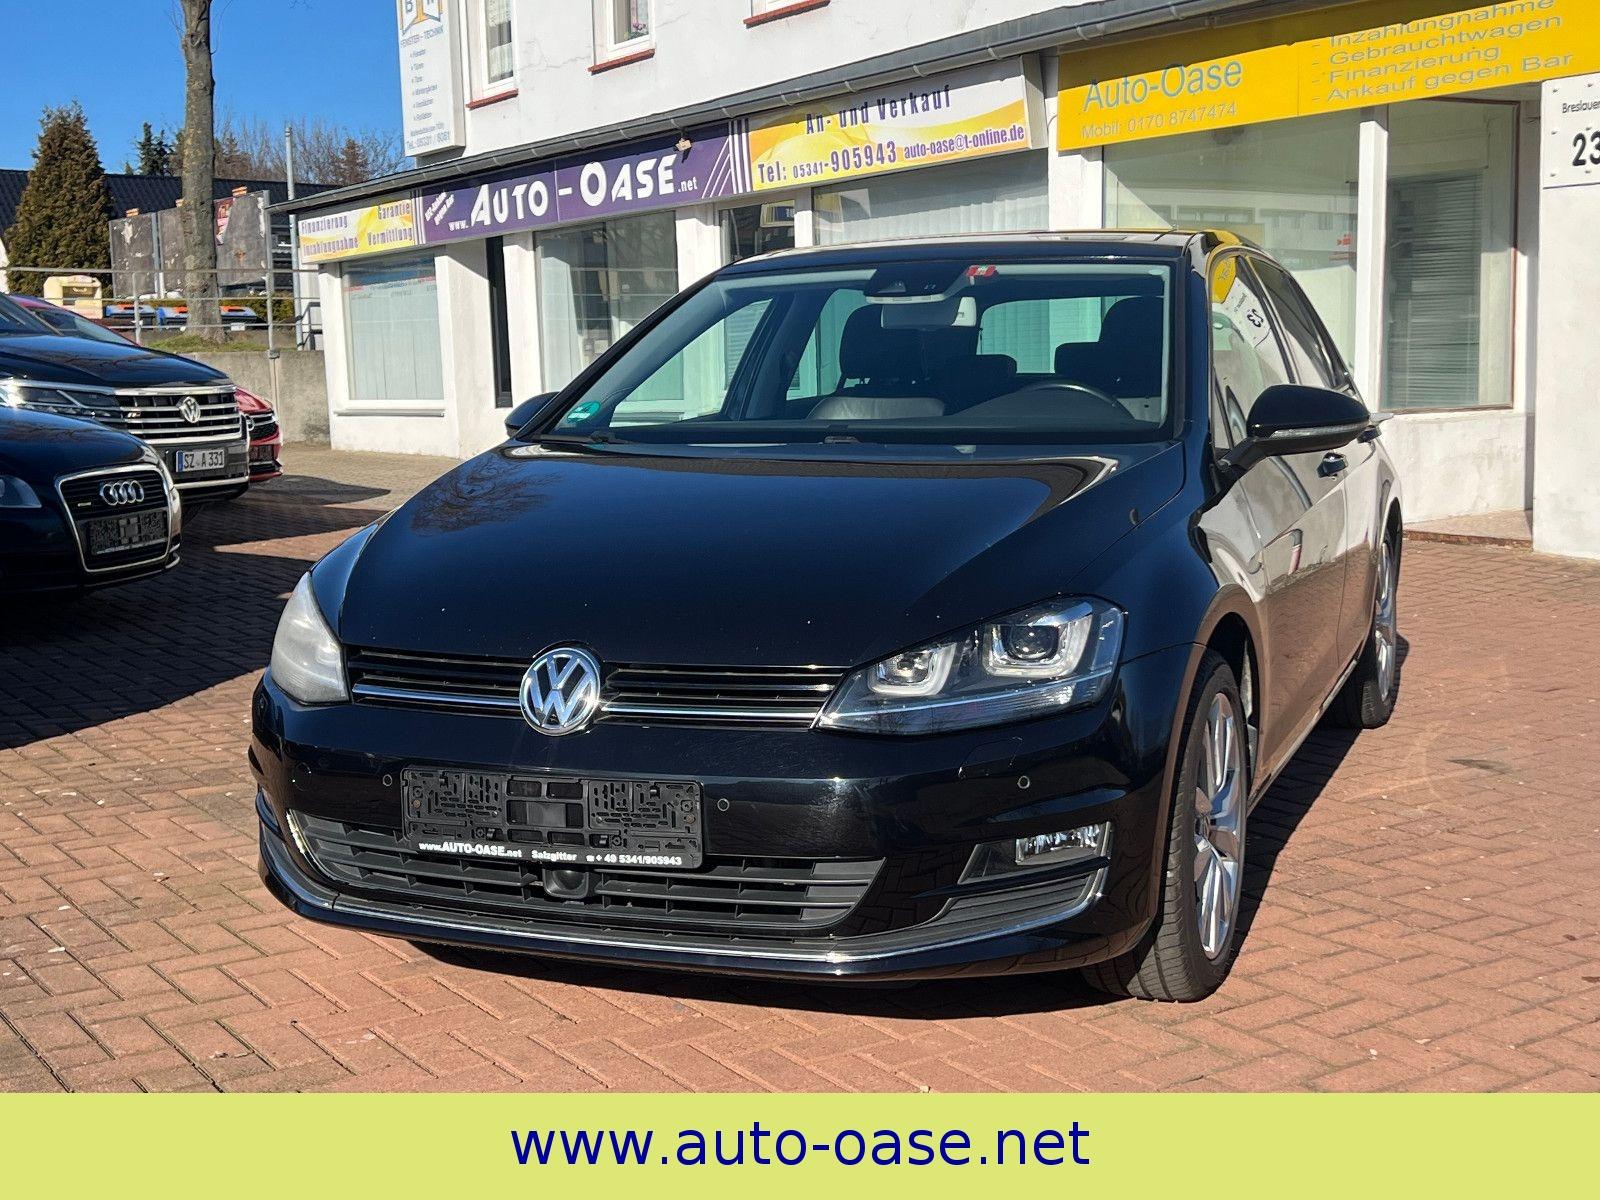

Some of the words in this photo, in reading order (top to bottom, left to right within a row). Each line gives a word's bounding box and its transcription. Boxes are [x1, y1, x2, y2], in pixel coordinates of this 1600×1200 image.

[1329, 0, 1555, 47] Inzahlungnahme
[1329, 14, 1562, 65] Gebrauchtwagen
[1327, 76, 1416, 102] Ankauf
[1424, 65, 1510, 90] gegen
[1521, 52, 1573, 72] Bar
[1329, 45, 1501, 83] Finanzierung
[839, 102, 869, 129] und
[877, 84, 952, 121] Verkauf
[1083, 60, 1243, 112] Auto-Oase
[1081, 120, 1122, 139] Mobil:
[1127, 113, 1165, 133] 0170
[1168, 101, 1237, 126] 8747474
[758, 163, 787, 184] Tel:
[904, 125, 1025, 159] auto-oase@t-online.de
[1572, 130, 1600, 167] 23
[301, 214, 348, 235] Finanzierung
[377, 202, 411, 220] Garantie
[184, 453, 195, 469] SZ
[201, 453, 207, 467] A
[208, 451, 224, 467] 331
[418, 841, 522, 858] www.AUTO-OASE.net
[531, 849, 578, 862] Salzgitter
